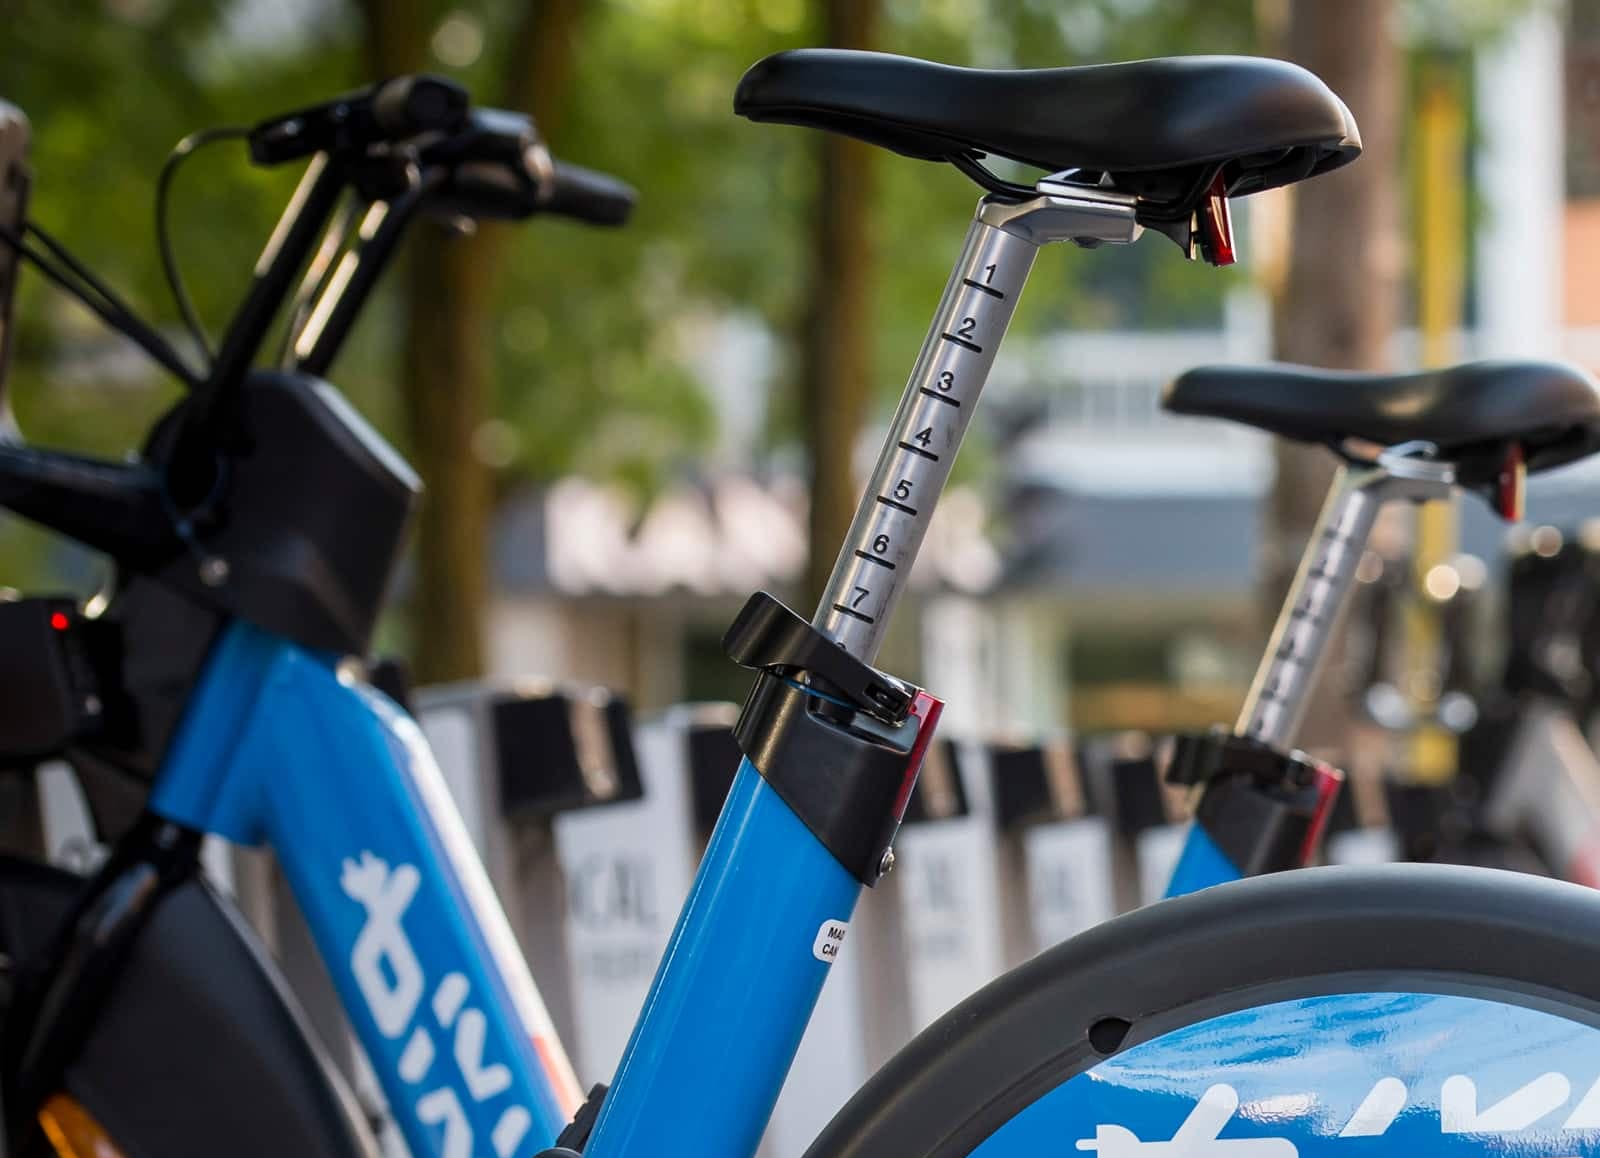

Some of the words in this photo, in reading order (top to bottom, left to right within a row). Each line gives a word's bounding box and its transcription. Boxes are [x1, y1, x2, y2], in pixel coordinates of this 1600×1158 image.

[985, 263, 997, 284] 1
[957, 317, 976, 340] 2
[937, 371, 954, 392] 3
[915, 427, 932, 447] 4
[893, 479, 913, 499] 5
[873, 534, 890, 554] 6
[855, 587, 869, 608] 7
